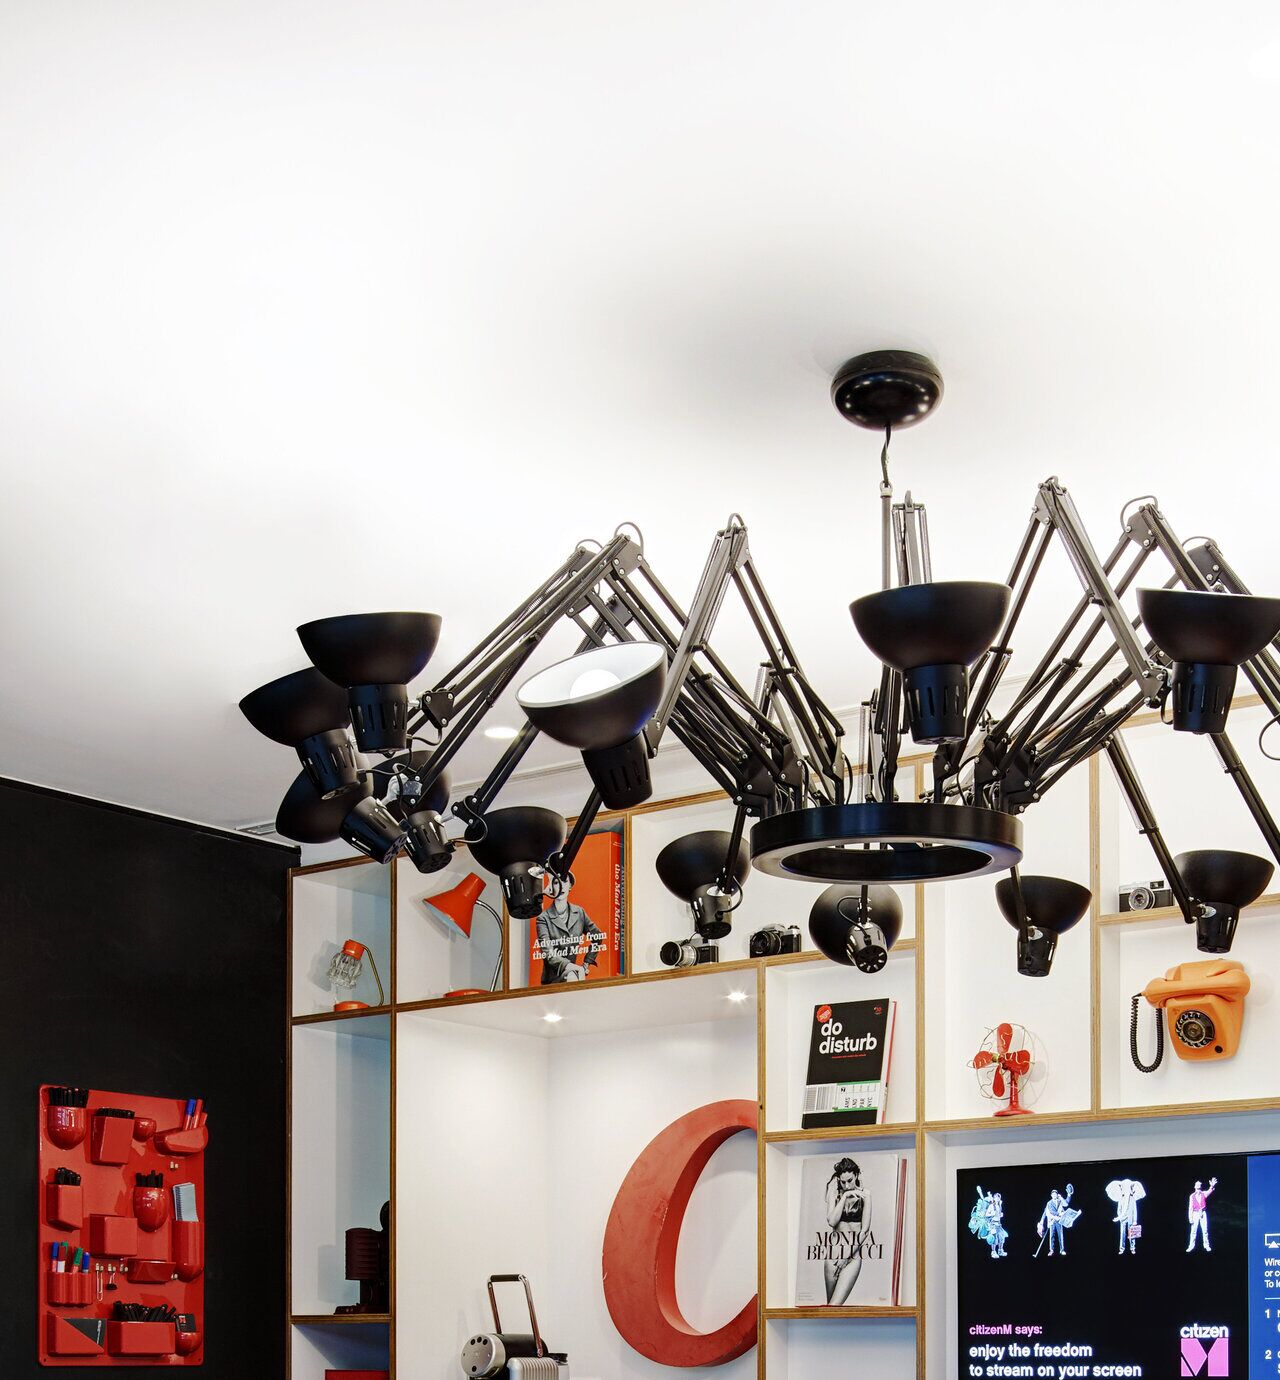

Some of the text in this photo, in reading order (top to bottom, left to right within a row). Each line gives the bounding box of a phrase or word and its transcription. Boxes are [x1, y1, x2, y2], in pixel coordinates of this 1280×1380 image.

[532, 931, 607, 949] Advertising from
[532, 943, 607, 960] the Mad Men Era
[821, 1018, 843, 1036] do
[819, 1033, 877, 1055] disturb
[816, 1231, 876, 1246] MONICA
[807, 1244, 884, 1260] BELLUCCI
[1264, 1280, 1275, 1288] To
[1264, 1309, 1271, 1319] 1
[969, 1324, 1043, 1337] citizenM says:
[1180, 1324, 1229, 1338] citizen
[969, 1343, 1093, 1361] enjoy the freedom
[1264, 1350, 1272, 1360] 2
[969, 1365, 1142, 1380] to stream on your screen
